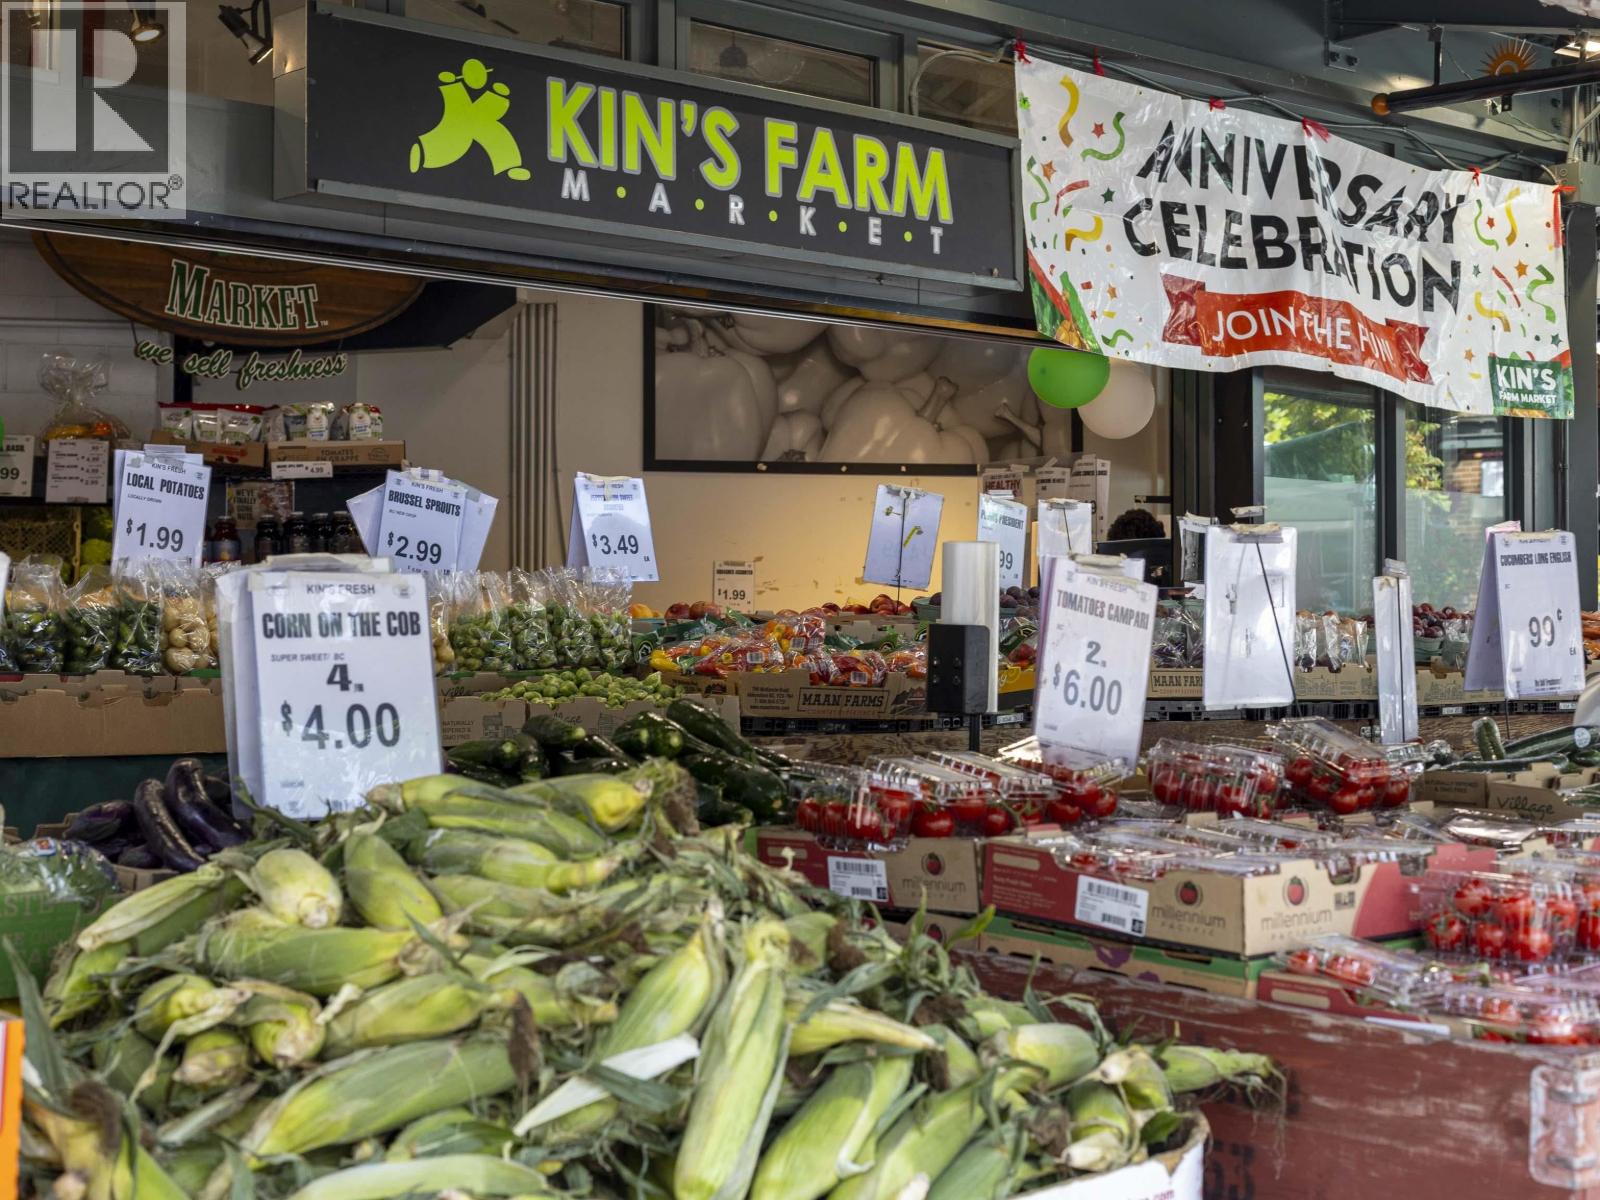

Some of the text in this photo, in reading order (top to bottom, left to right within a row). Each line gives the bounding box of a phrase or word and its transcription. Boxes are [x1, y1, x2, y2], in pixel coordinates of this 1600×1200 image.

[546, 76, 953, 224] KIN'S FARM
[1122, 197, 1462, 315] CELEBRATION
[1212, 306, 1295, 342] JOIN
[1300, 309, 1352, 350] THE
[135, 340, 346, 391] we sell freshness
[1496, 364, 1557, 391] KIN'S
[1499, 390, 1557, 404] FARM MARKET
[127, 472, 205, 500] LOCAL POTATOES
[426, 484, 444, 493] FRESH
[388, 490, 461, 517] BRUSSEL SPROUTS
[126, 518, 184, 552] $1.99
[387, 531, 442, 564] $2.99
[592, 533, 639, 555] $3.49
[1535, 552, 1549, 564] LONG
[1550, 551, 1572, 564] ENGLISH
[339, 584, 375, 595] FRESH
[1056, 590, 1150, 630] TOMATOES CAMPARI
[262, 611, 421, 639] CORN ON THE COB
[271, 653, 297, 662] SUPER
[802, 693, 842, 706] MAAN
[844, 695, 884, 707] FARMS
[1053, 662, 1122, 716] $6.00
[281, 701, 400, 750] $4.00
[1496, 796, 1555, 820] Village
[1152, 903, 1226, 929] millennium
[1261, 905, 1332, 930] millennium
